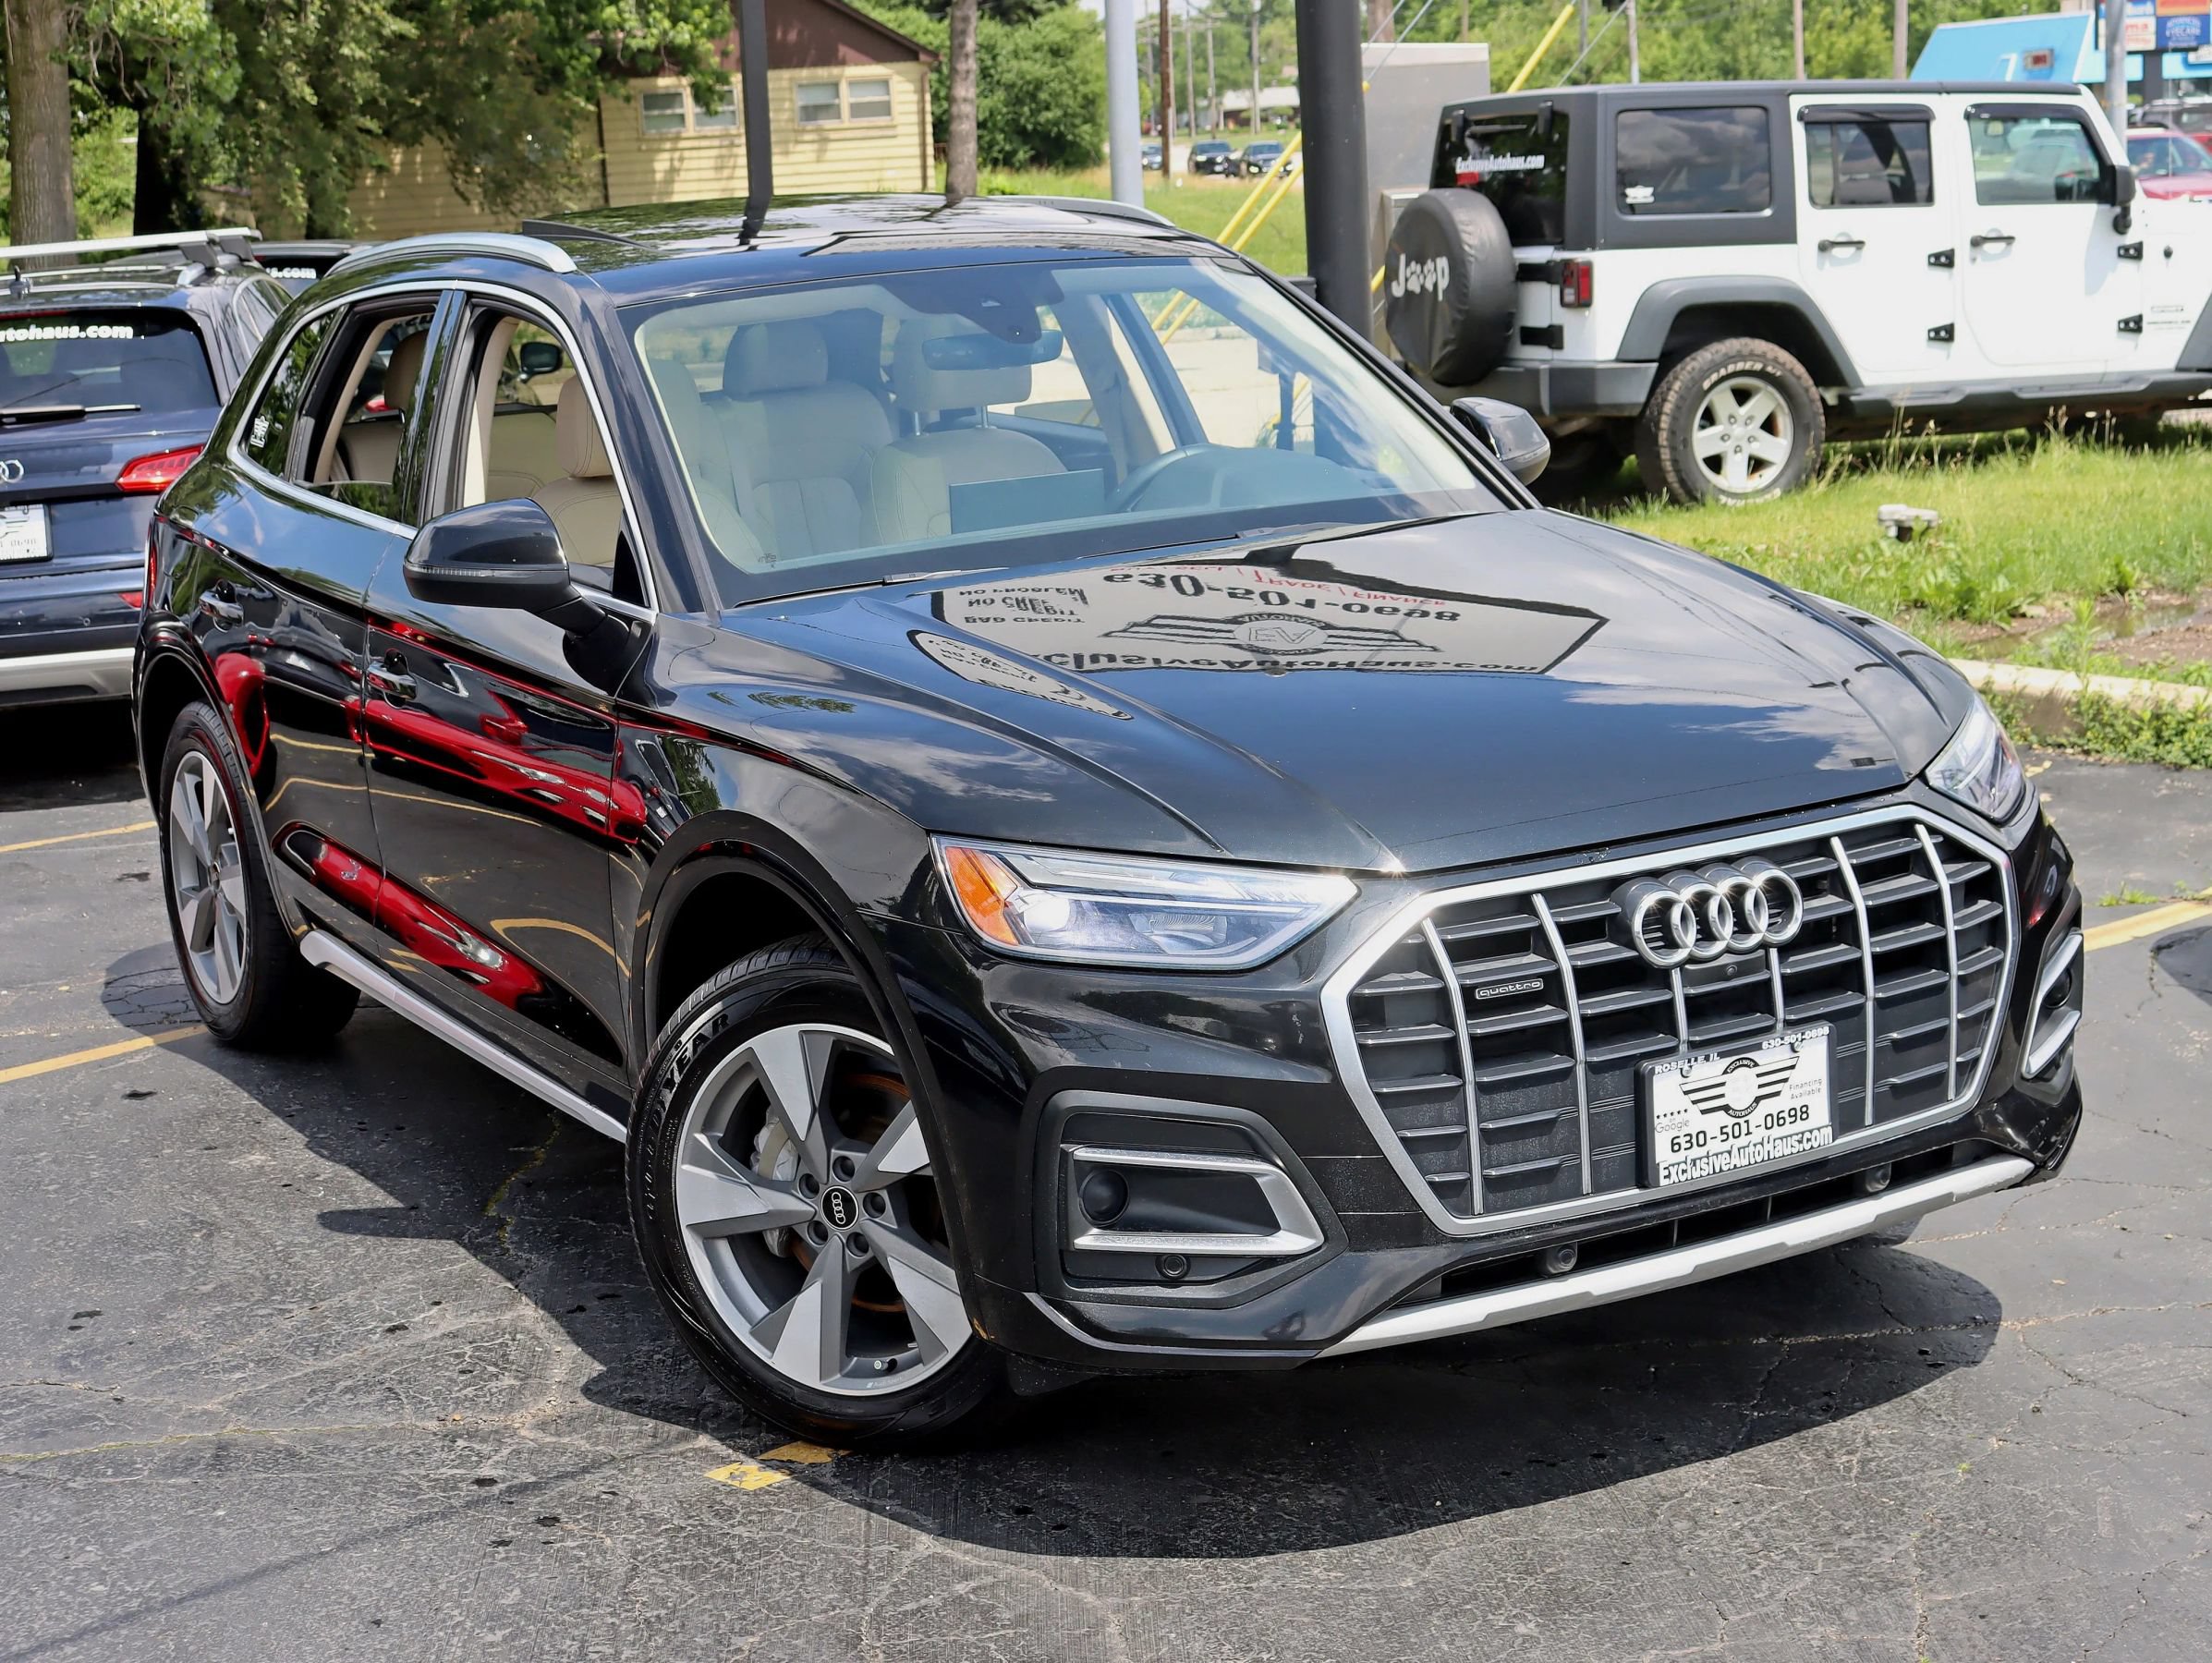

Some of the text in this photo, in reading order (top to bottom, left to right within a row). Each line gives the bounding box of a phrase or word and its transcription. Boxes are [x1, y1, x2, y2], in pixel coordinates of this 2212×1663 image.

[1479, 981, 1541, 997] quattro
[1761, 1026, 1830, 1050] 630-501-0698
[1708, 1052, 1720, 1062] IL
[1727, 1058, 1756, 1074] EXCLUSIVE
[1789, 1078, 1823, 1091] Financing
[1790, 1086, 1822, 1100] Available
[1727, 1102, 1757, 1117] AUTOHAUS
[1655, 1119, 1690, 1134] Google
[1671, 1104, 1810, 1154] 630-501-0698
[1659, 1124, 1833, 1186] ExclusiveAutoHaus.com
